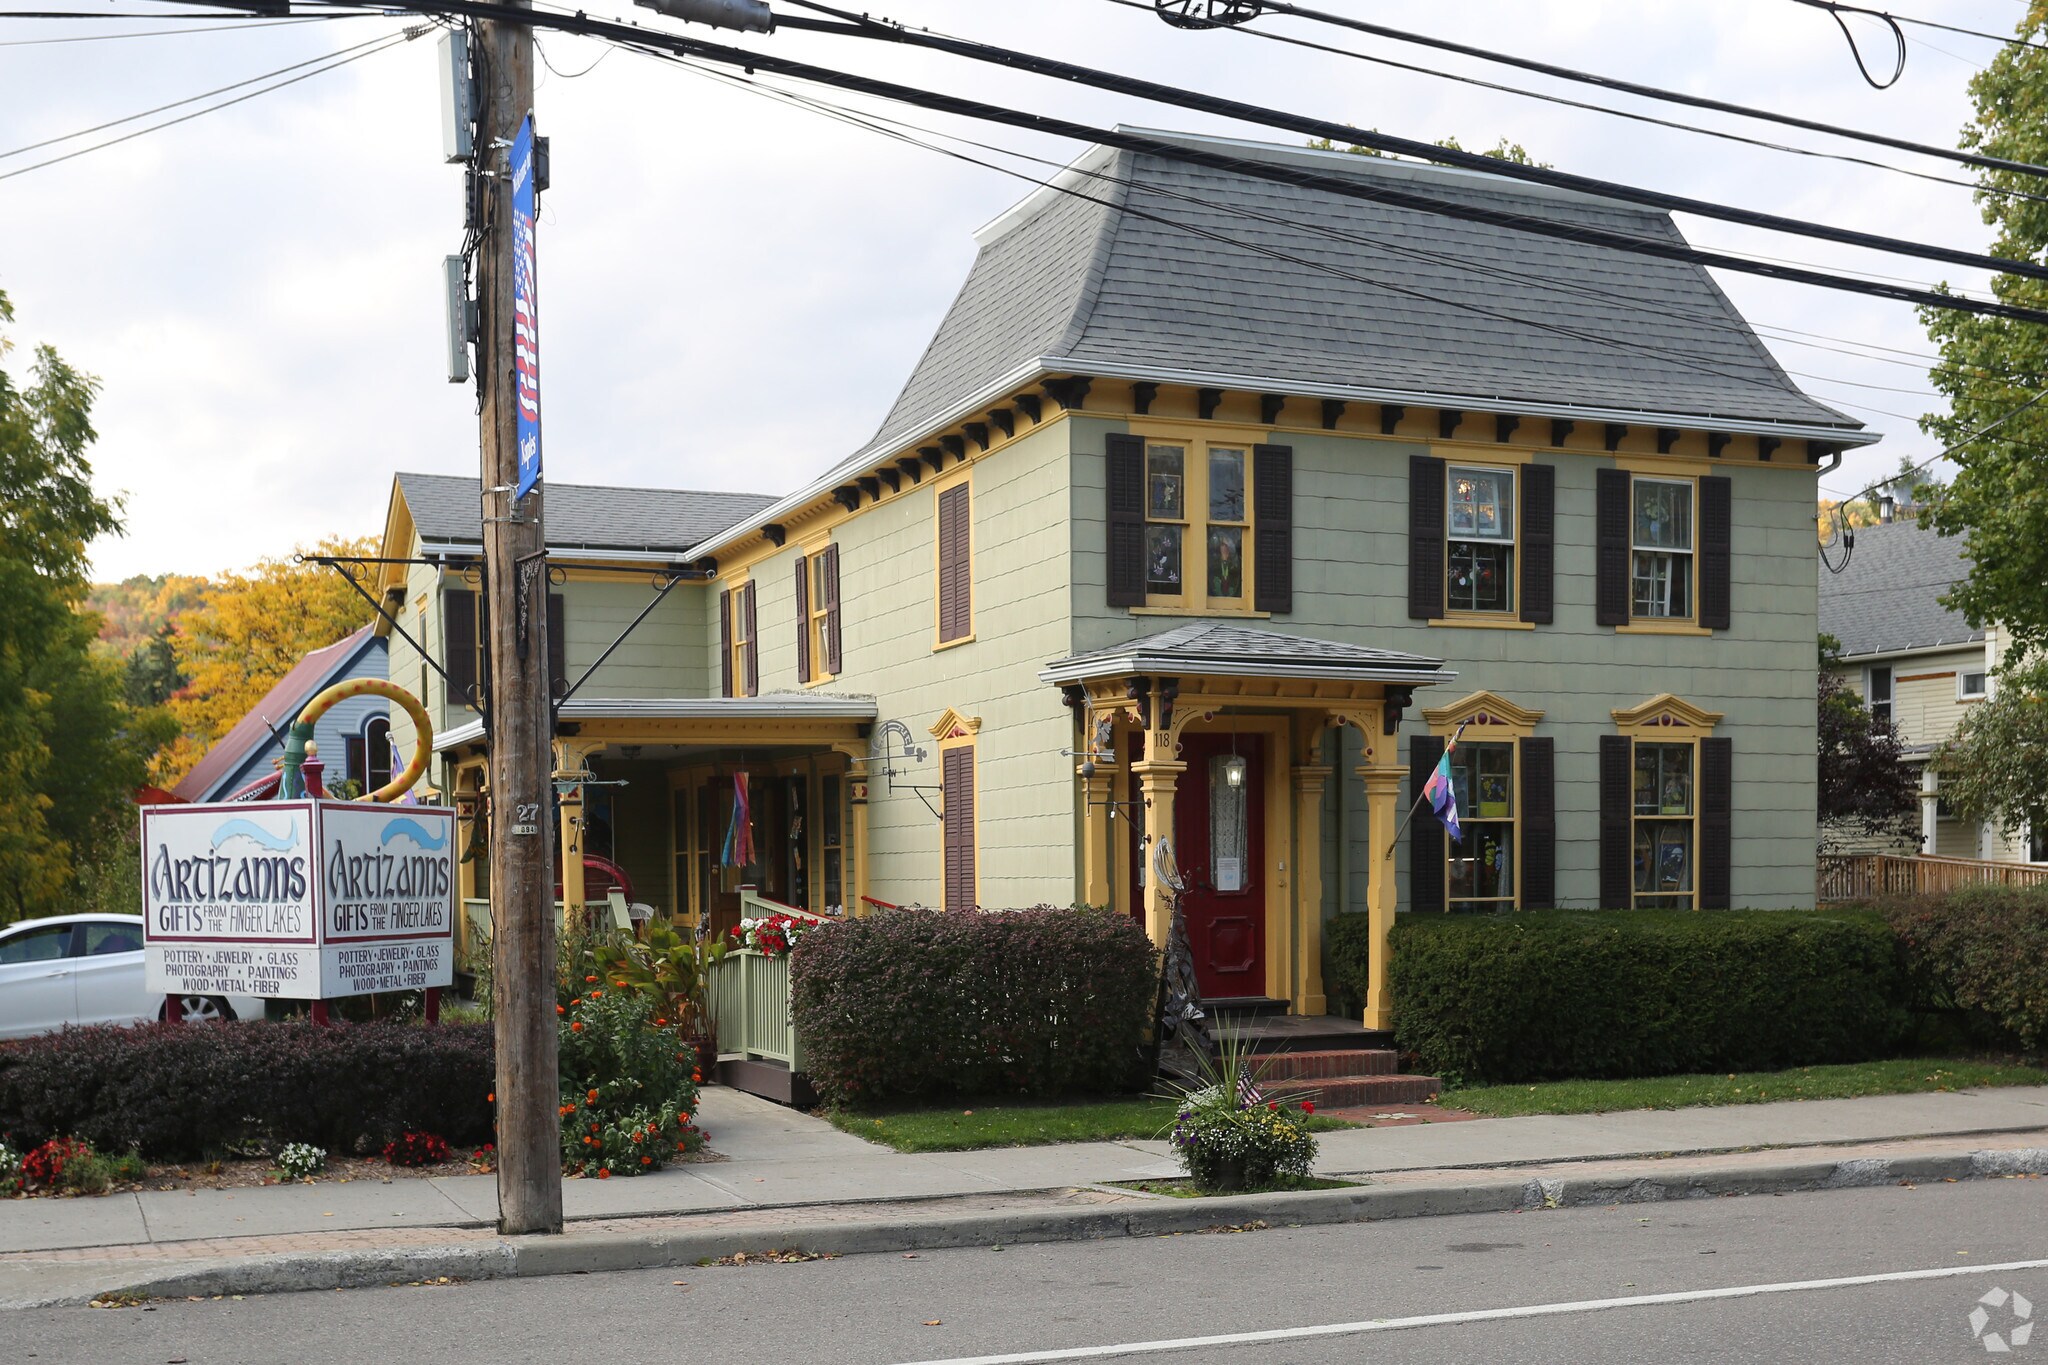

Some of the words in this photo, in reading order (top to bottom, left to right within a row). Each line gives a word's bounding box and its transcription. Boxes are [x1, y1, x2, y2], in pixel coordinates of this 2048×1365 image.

[520, 432, 536, 470] Naples
[1154, 733, 1170, 748] 118
[516, 803, 539, 822] 27
[159, 905, 202, 931] GIFTS
[204, 905, 227, 918] FROM
[230, 905, 263, 932] FINGER
[334, 904, 368, 931] GIFTS
[370, 903, 388, 916] FROM
[391, 902, 420, 929] FINGER
[421, 902, 442, 927] LAKES
[209, 920, 223, 932] THE
[265, 905, 301, 933] LAKES
[372, 917, 386, 929] THE
[164, 951, 203, 963] POTTERY
[213, 952, 252, 964] JEWELRY
[268, 952, 298, 964] GLASS
[338, 950, 373, 964] POTTERY
[377, 947, 410, 961] JEWELRY
[416, 946, 440, 958] GLASS
[166, 964, 229, 977] PHOTOGRAPHY
[248, 966, 297, 980] PAINTINGS
[339, 962, 394, 977] PHOTOGRAPHY
[403, 959, 438, 972] PAINTINGS
[183, 978, 209, 991] WOOD
[216, 979, 247, 992] METAL
[253, 979, 280, 993] FIBER
[353, 977, 376, 991] WOOD
[380, 975, 402, 988] METAL
[407, 972, 426, 985] FIBER
